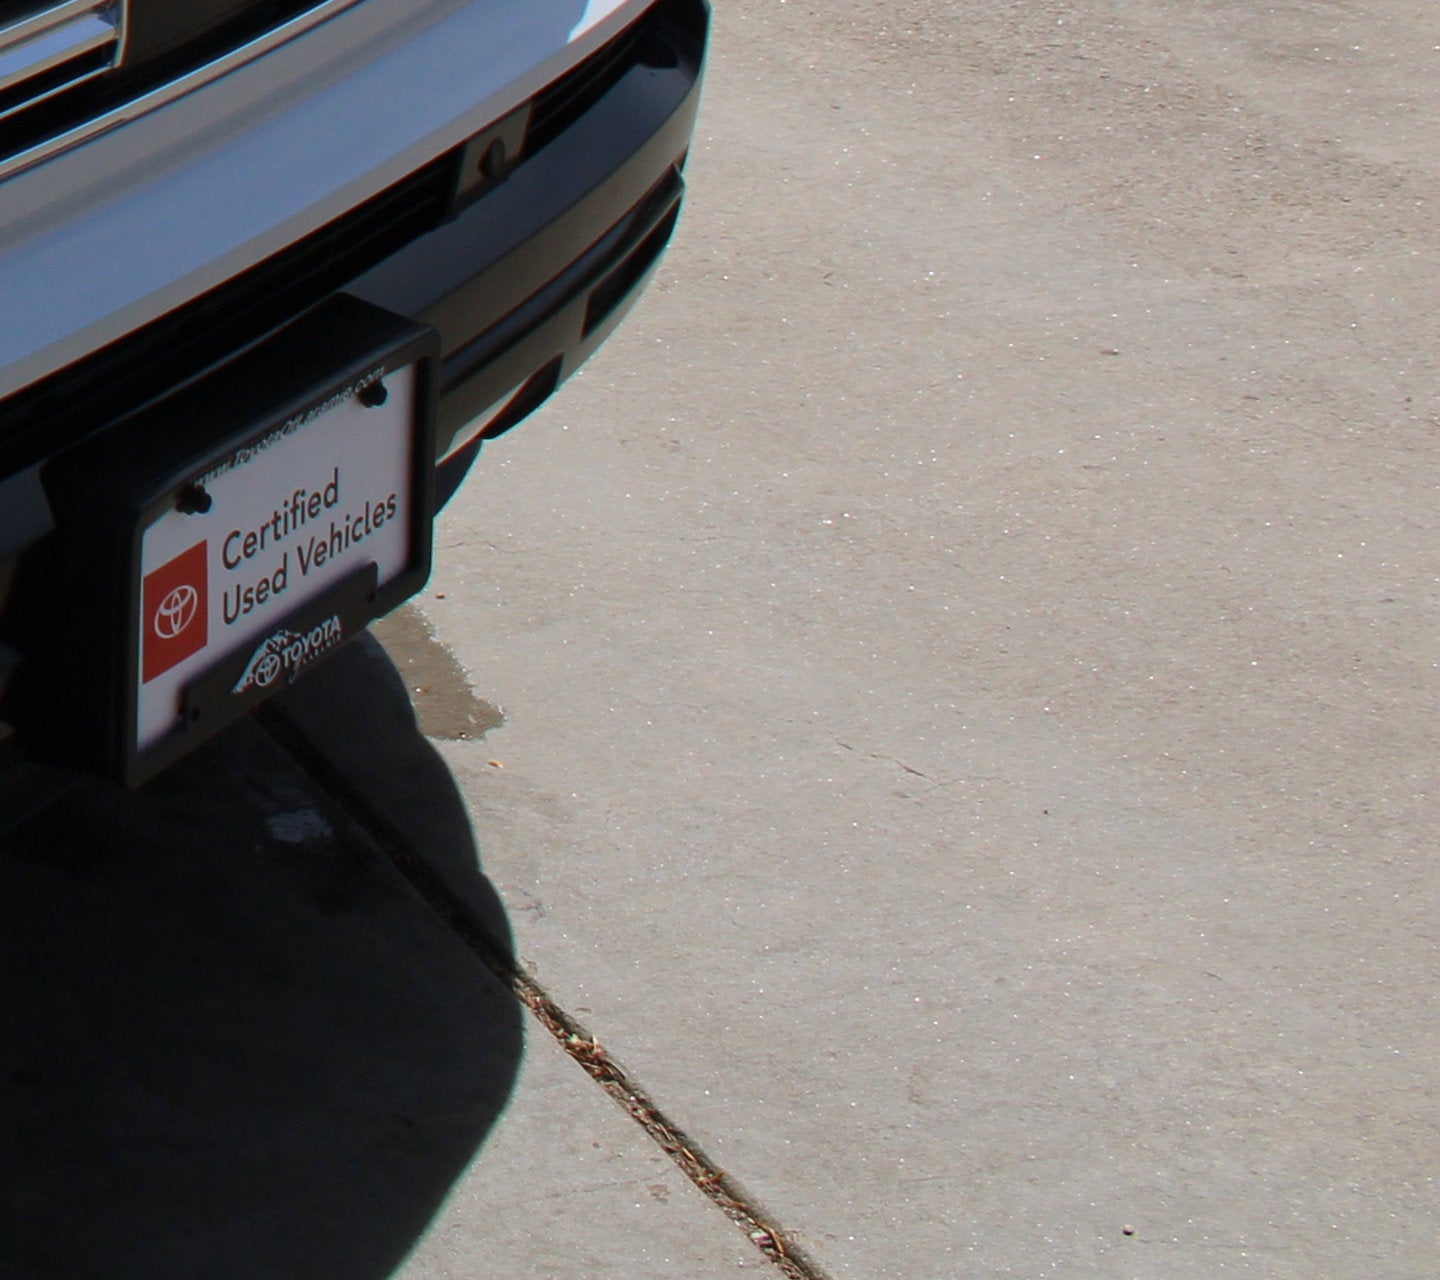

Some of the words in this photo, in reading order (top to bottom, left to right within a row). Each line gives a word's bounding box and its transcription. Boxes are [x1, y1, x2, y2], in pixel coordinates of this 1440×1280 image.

[221, 466, 340, 571] Certified
[222, 557, 288, 626] Used
[296, 492, 397, 578] Vehicles
[280, 614, 342, 668] TOYOTA
